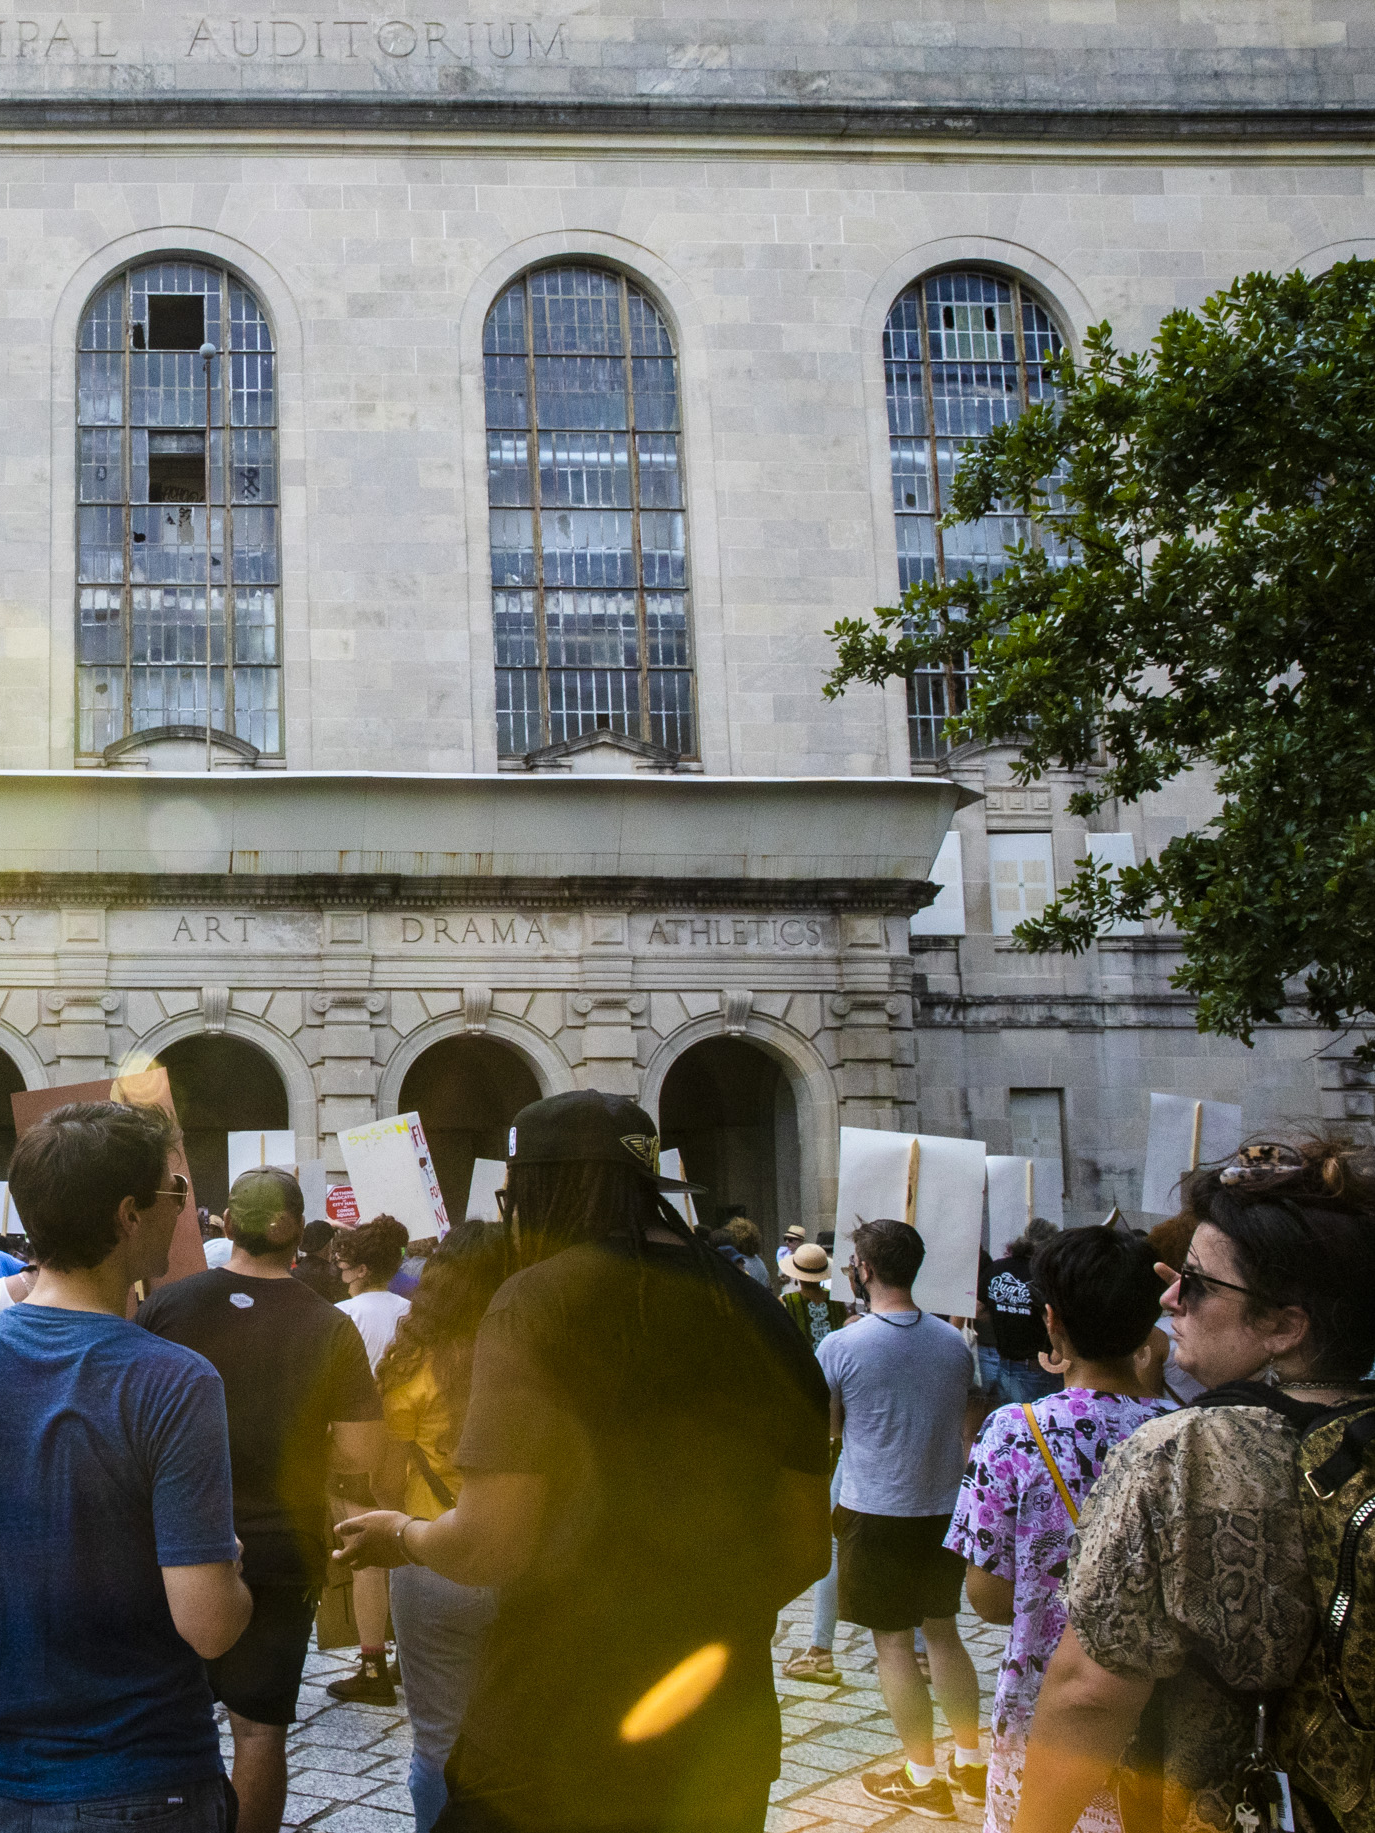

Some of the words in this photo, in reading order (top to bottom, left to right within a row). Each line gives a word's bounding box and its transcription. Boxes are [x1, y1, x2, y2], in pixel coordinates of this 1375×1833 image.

[184, 20, 570, 61] AUDITORIUM
[171, 915, 257, 943] ART
[400, 916, 549, 945] DRAMA
[646, 918, 822, 946] ATHLETICS
